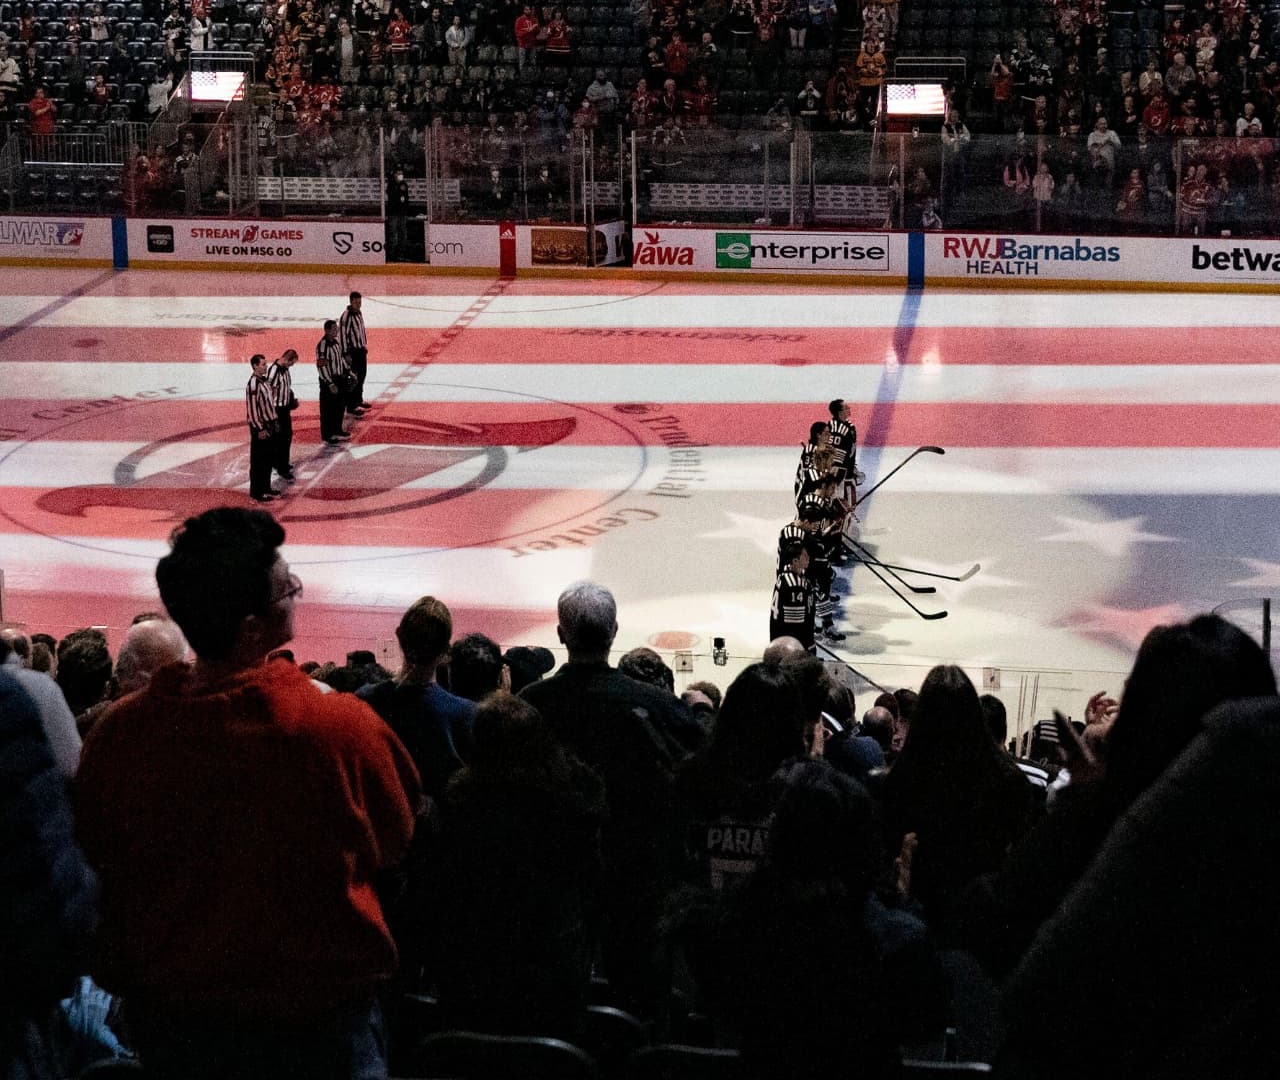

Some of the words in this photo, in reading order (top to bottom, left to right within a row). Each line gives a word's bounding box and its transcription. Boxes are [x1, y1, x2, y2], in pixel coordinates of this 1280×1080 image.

[190, 228, 240, 239] STREAM
[261, 229, 304, 240] GAMES
[206, 245, 230, 256] LIVE
[232, 246, 248, 256] ON
[250, 246, 274, 256] MSG
[276, 247, 292, 257] GO
[717, 240, 886, 263] enterprise
[966, 260, 1039, 275] HEALTH
[32, 384, 181, 422] Center
[505, 508, 660, 559] Center
[707, 827, 769, 855] PARA
